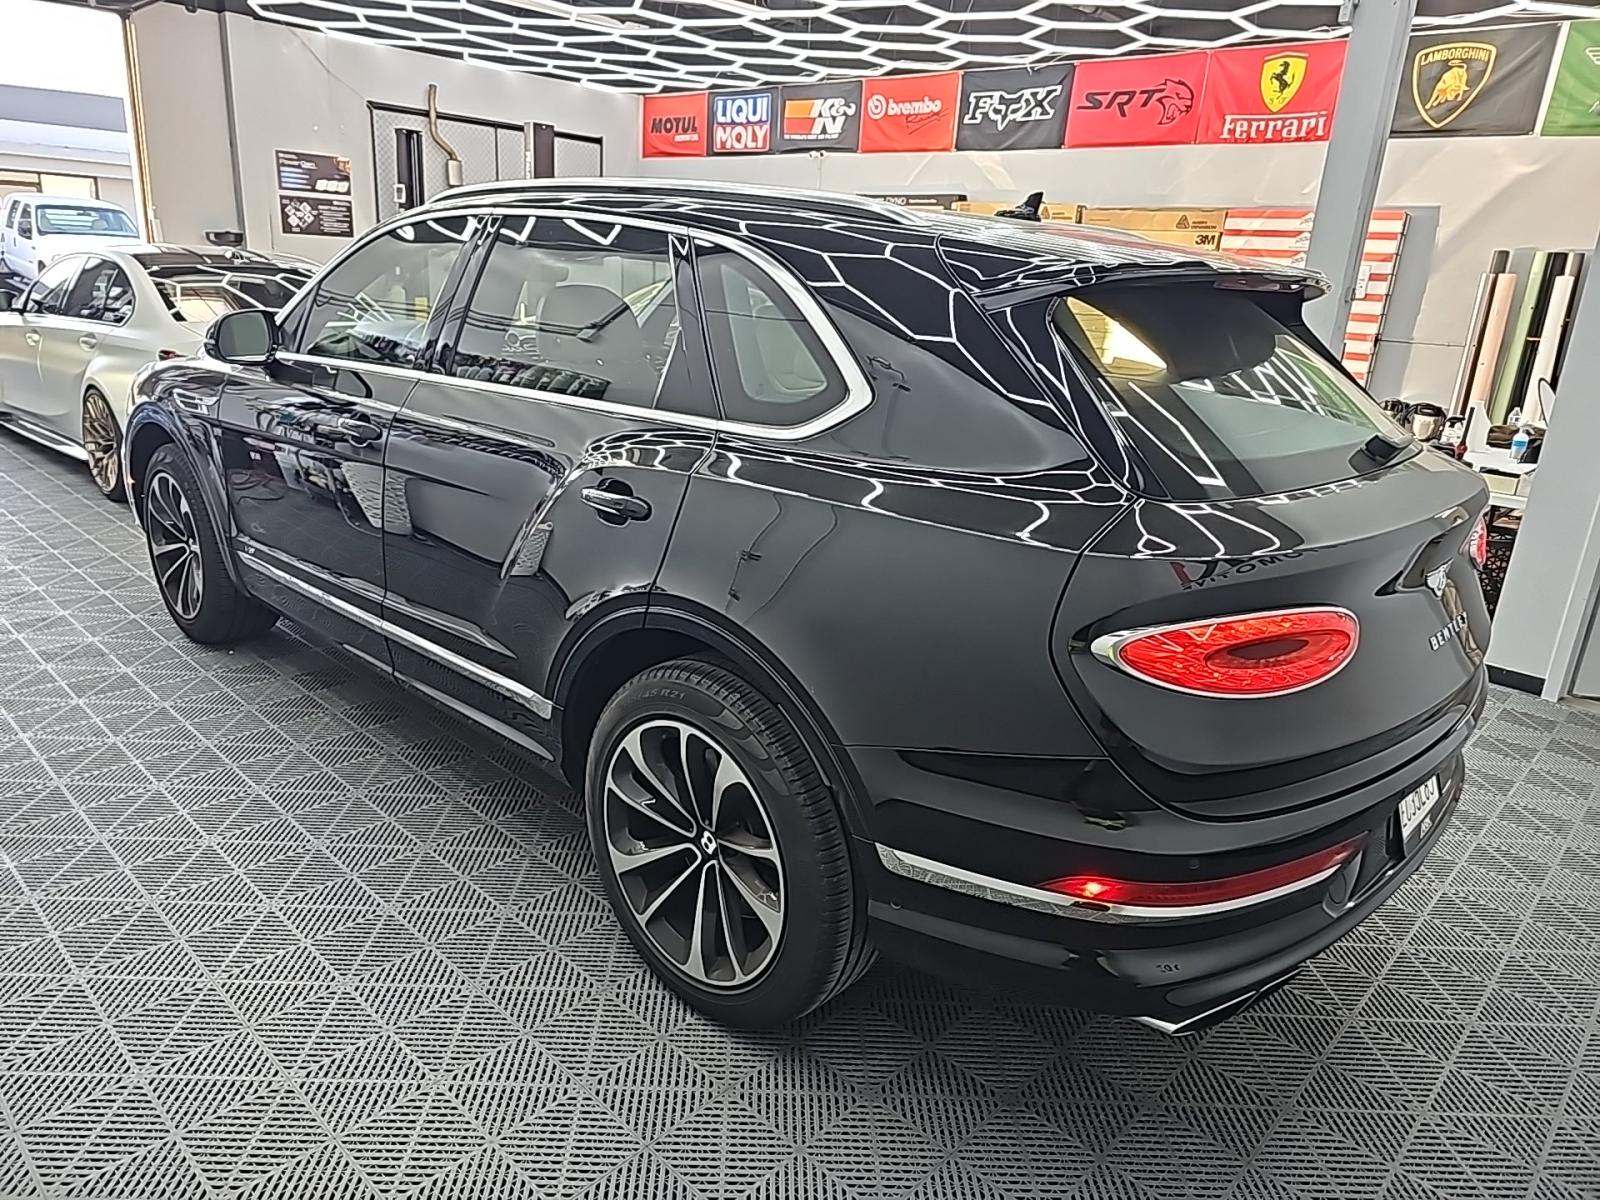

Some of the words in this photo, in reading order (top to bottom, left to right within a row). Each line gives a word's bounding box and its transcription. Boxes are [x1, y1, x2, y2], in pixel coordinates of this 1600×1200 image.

[1420, 47, 1489, 65] LAMBORGHINI
[716, 97, 768, 124] LIQUI
[888, 96, 942, 115] brembo
[1076, 88, 1167, 118] SRT
[651, 115, 698, 133] MOTUL
[1219, 111, 1328, 138] Ferrari
[716, 125, 768, 149] MOLY
[1195, 235, 1216, 245] 3M
